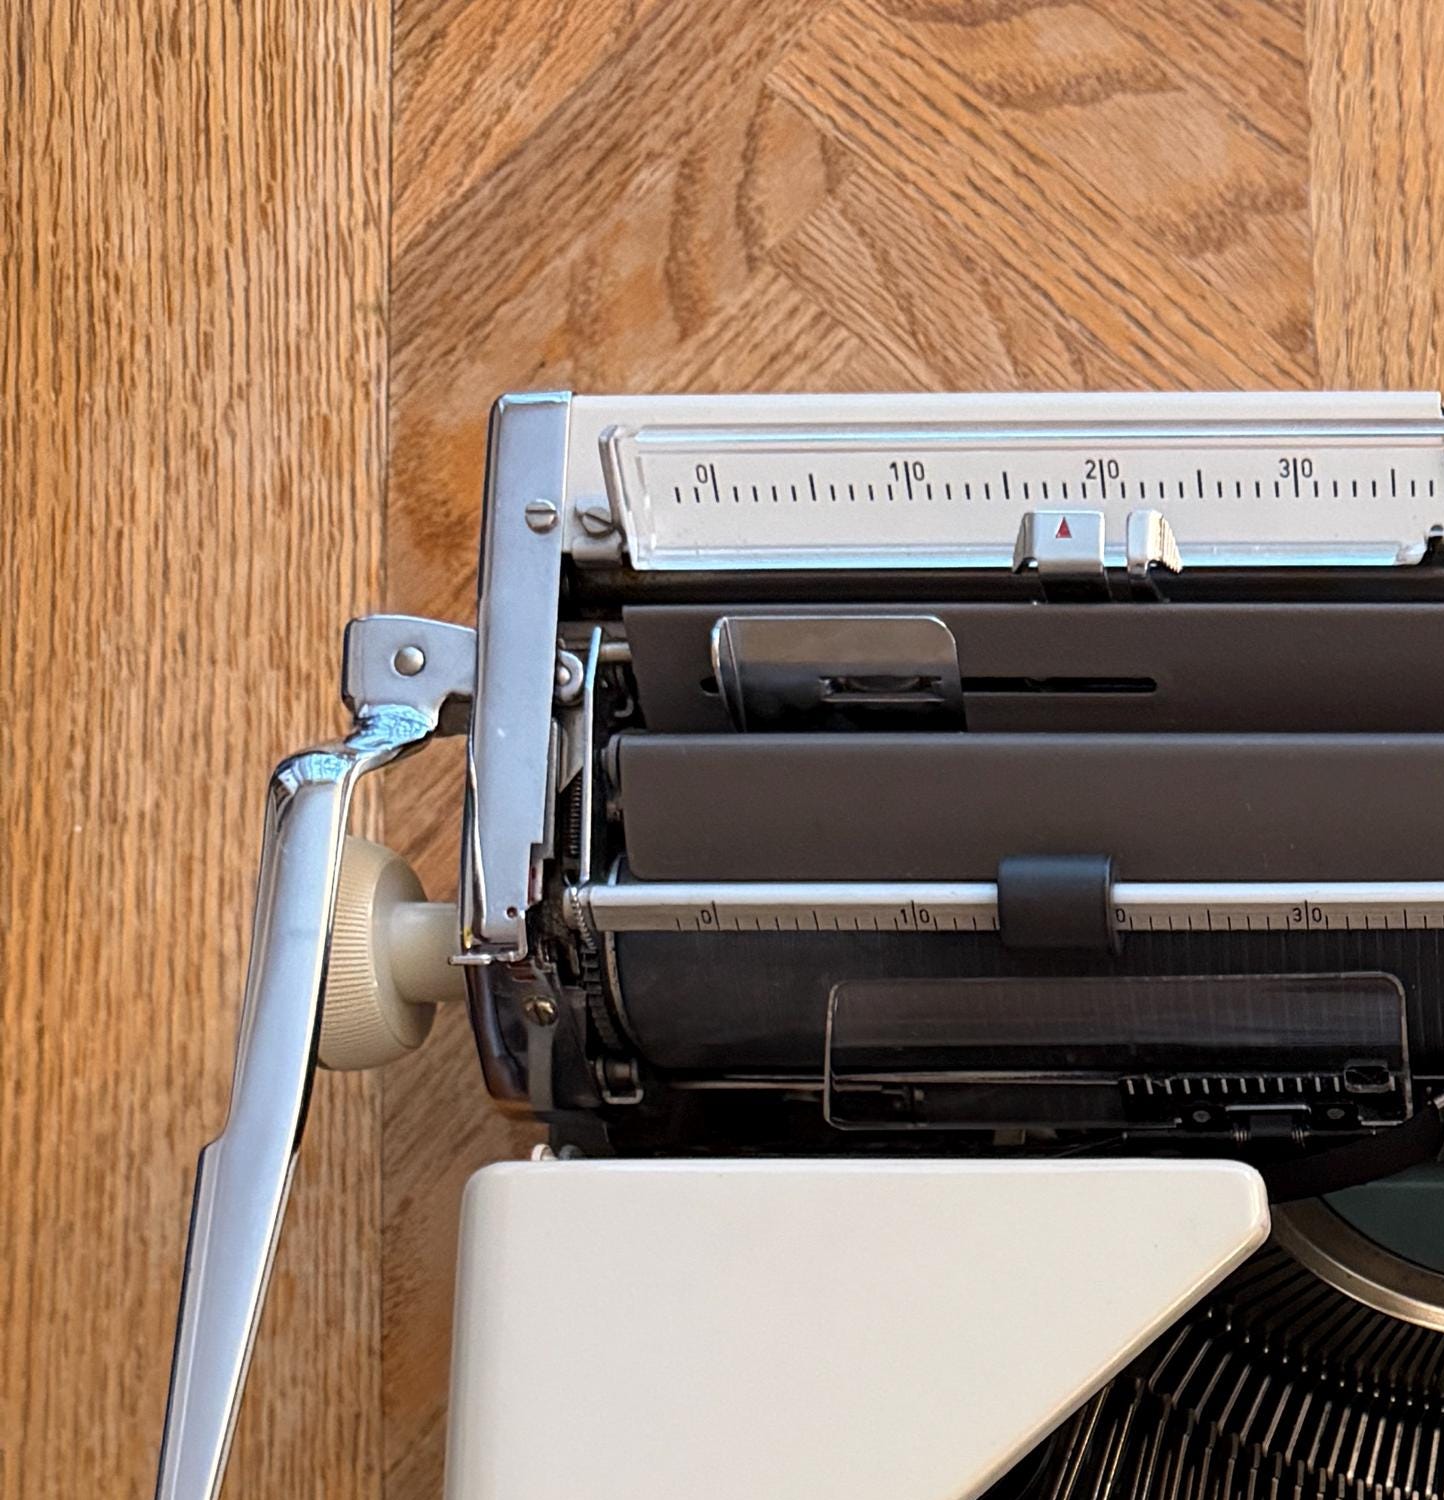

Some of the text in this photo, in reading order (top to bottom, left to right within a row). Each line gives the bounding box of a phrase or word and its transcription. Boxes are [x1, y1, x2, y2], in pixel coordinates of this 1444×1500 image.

[695, 464, 709, 485] 0
[889, 461, 925, 482] 10
[1085, 459, 1120, 480] 20
[1279, 458, 1313, 479] 30
[701, 909, 712, 925] 0
[900, 908, 930, 924] 10
[1116, 907, 1126, 924] 0
[1292, 907, 1322, 923] 30
